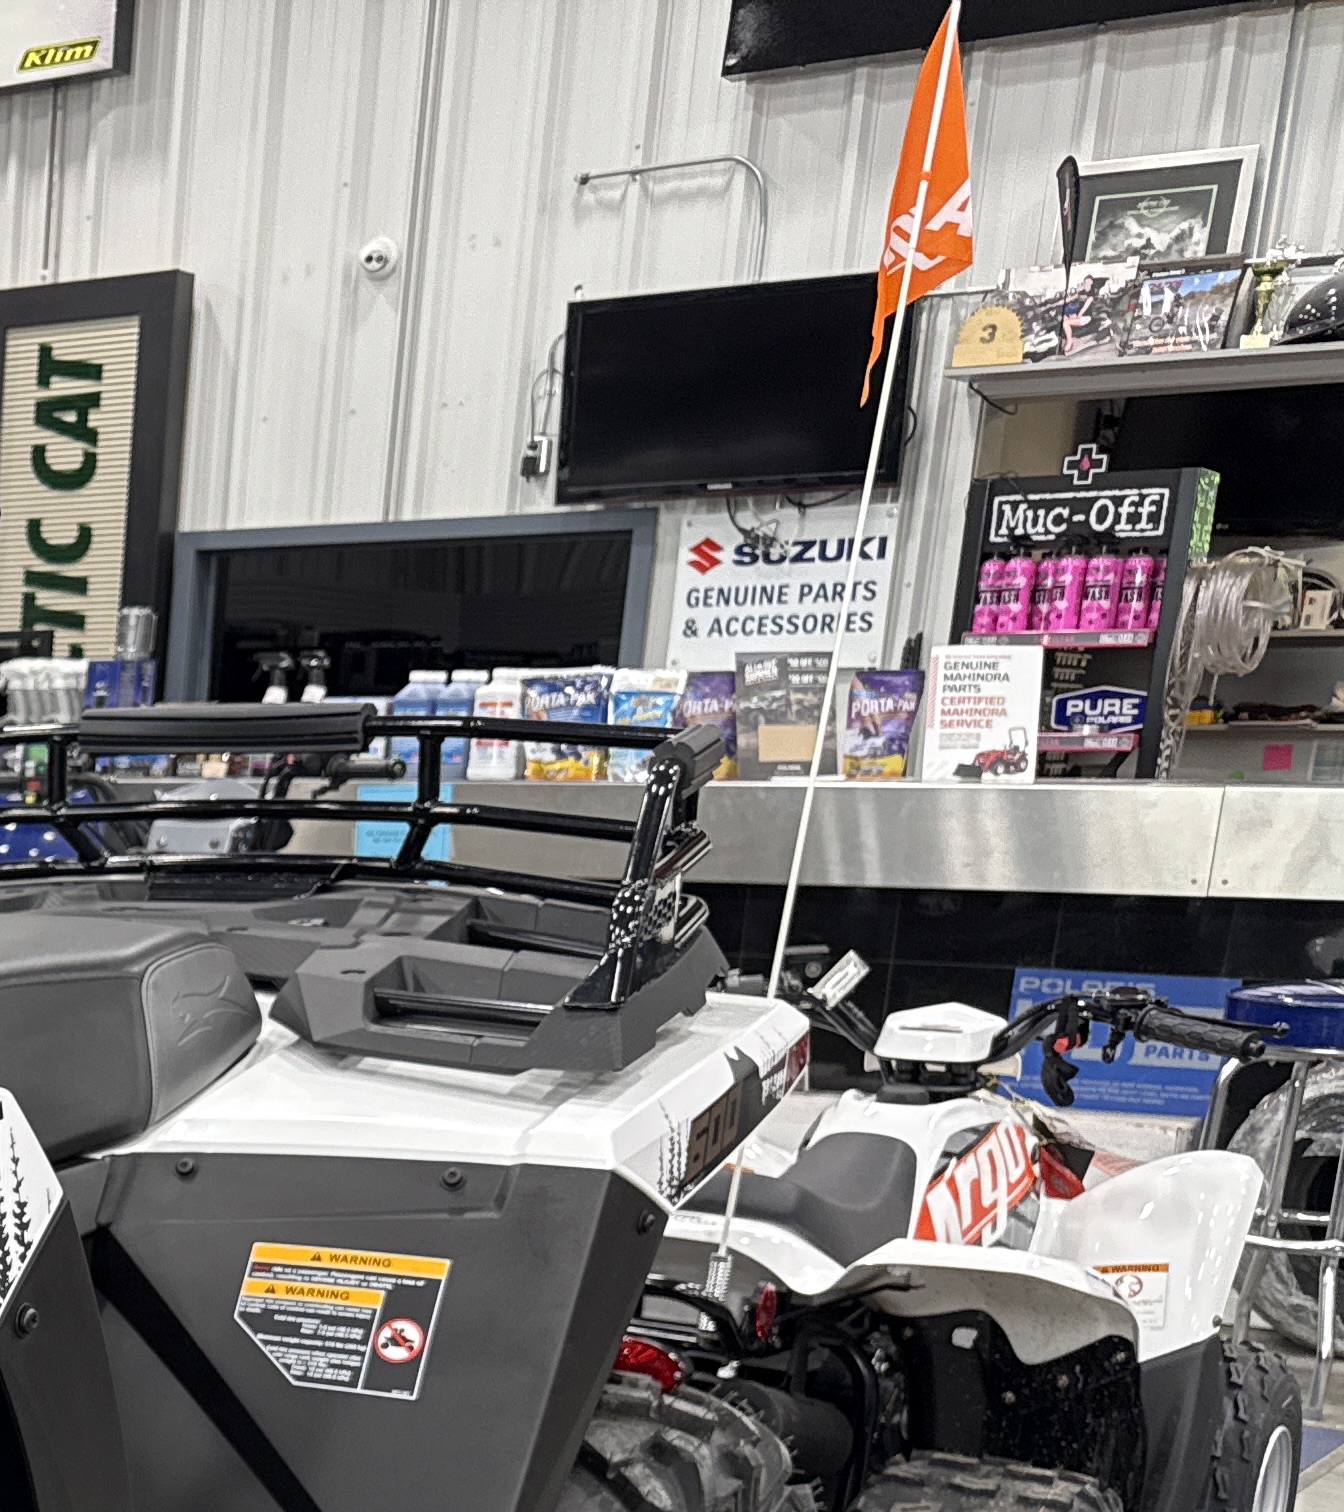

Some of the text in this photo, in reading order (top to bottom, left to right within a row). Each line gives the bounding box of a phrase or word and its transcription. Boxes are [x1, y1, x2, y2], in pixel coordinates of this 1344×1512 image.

[23, 44, 93, 68] Klim
[979, 324, 998, 344] 3
[30, 342, 103, 492] CAT
[997, 494, 1161, 536] Muc-Off
[732, 536, 889, 567] SUZUKI
[21, 518, 92, 659] TIC
[685, 580, 878, 609] GENUINE PARTS
[681, 611, 874, 639] & ACCESSORIES
[943, 660, 1000, 672] GENUINE
[943, 672, 1011, 683] MAHINDRA
[942, 684, 982, 695] PARTS
[676, 698, 736, 718] PORTA-P
[940, 695, 1006, 707] CERTIFIED
[1065, 698, 1141, 717] PURE
[940, 707, 1008, 718] MAHINDRA
[938, 718, 994, 730] SERVICE
[1019, 976, 1157, 1000] POLAS
[329, 1252, 393, 1269] WARNING
[283, 1285, 351, 1302] WARNING
